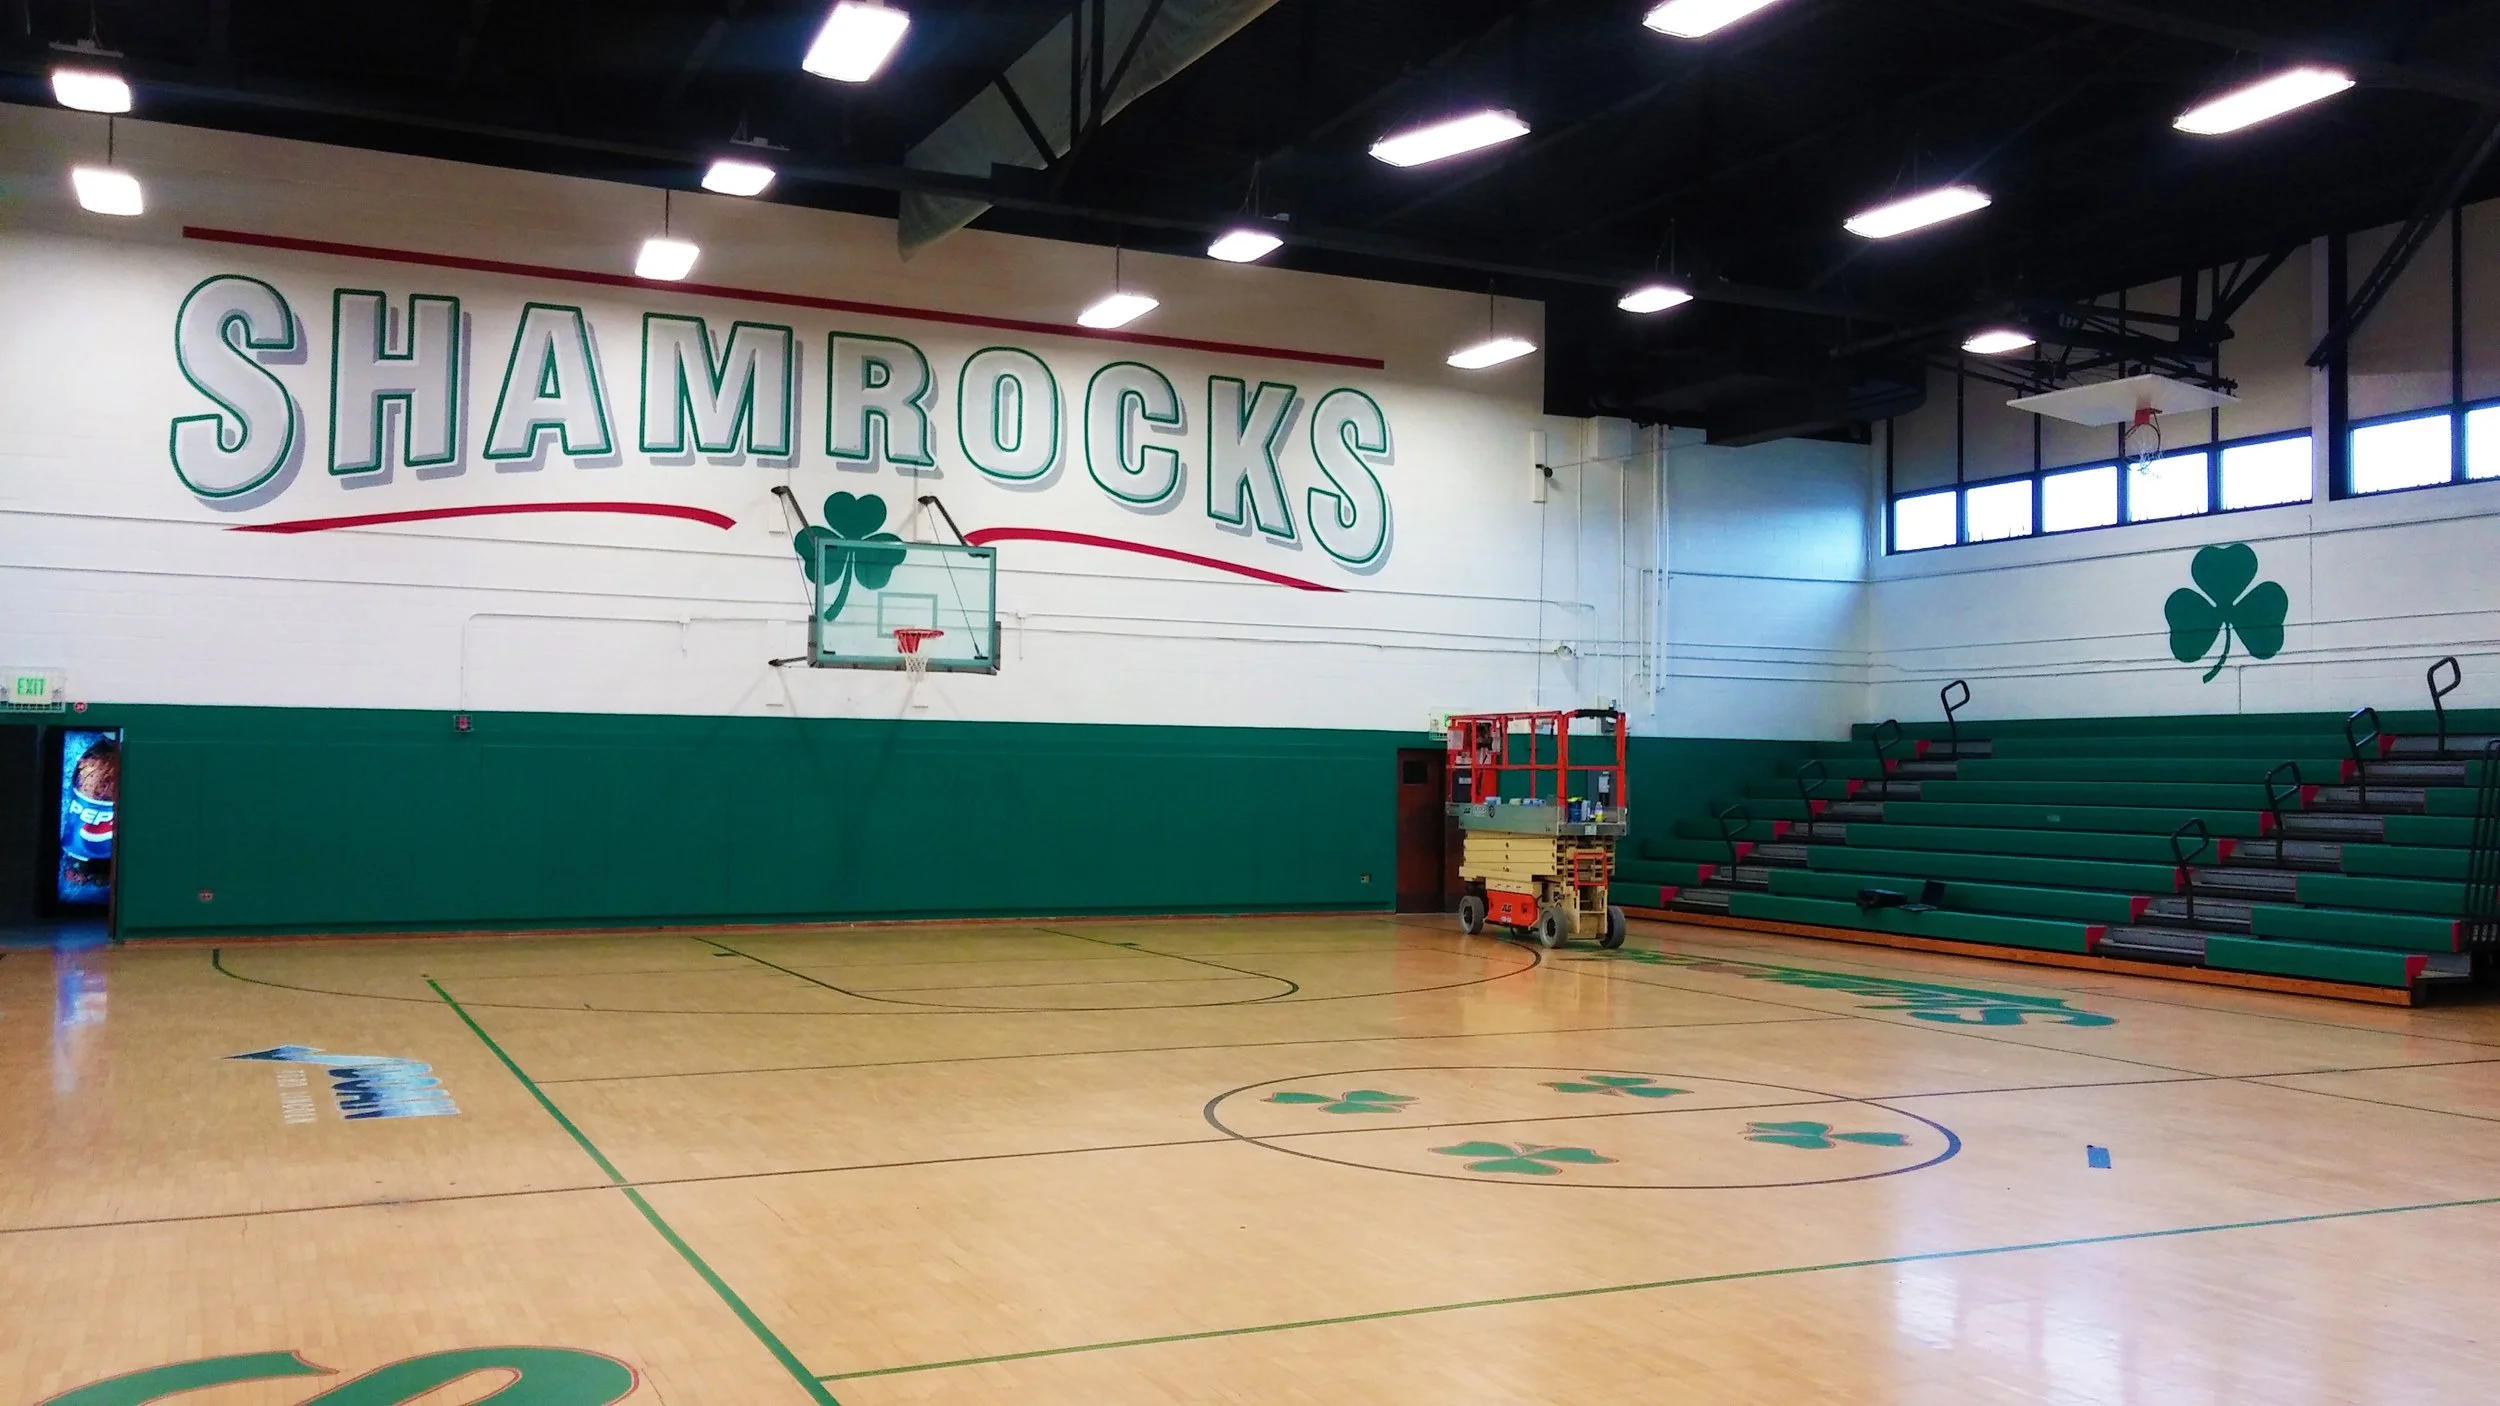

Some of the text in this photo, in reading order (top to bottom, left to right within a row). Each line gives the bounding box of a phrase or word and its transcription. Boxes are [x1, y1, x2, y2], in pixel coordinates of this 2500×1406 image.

[170, 273, 1393, 572] SHAMROCKS
[16, 676, 46, 697] EXIT
[69, 800, 114, 826] PEP
